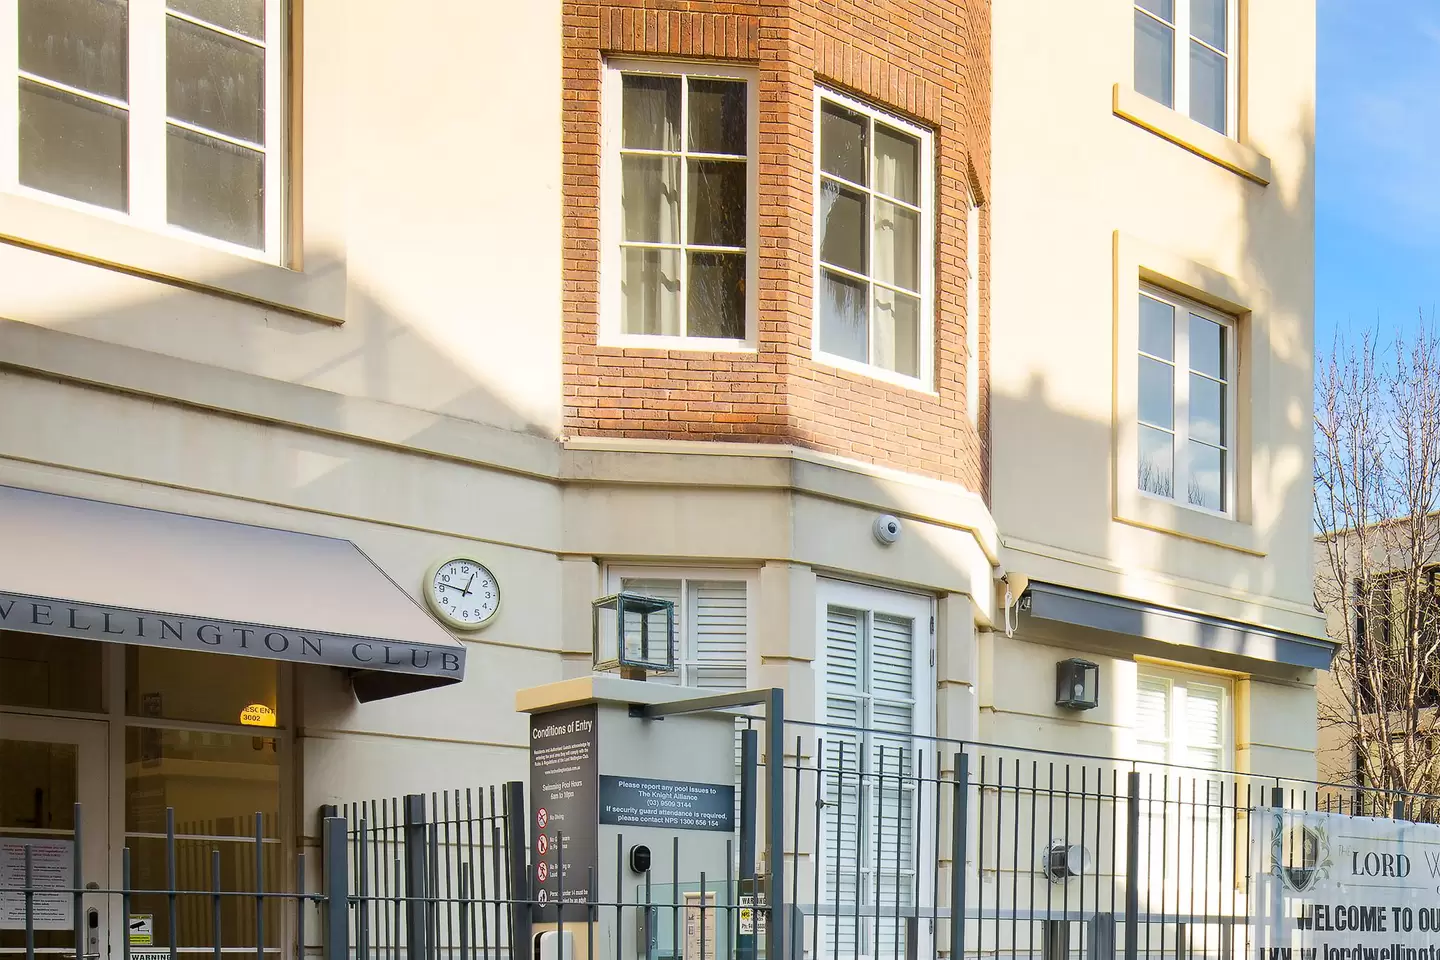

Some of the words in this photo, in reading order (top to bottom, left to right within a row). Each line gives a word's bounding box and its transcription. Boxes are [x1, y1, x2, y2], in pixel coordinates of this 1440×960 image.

[451, 567, 457, 575] 11
[461, 566, 469, 574] 12
[442, 574, 450, 582] 10
[462, 610, 468, 618] 6
[351, 642, 460, 672] CLUB
[243, 714, 261, 722] 3002
[532, 724, 567, 740] Conditions
[567, 721, 575, 734] of
[575, 719, 593, 733] Entry
[542, 783, 561, 791] Swimming
[561, 781, 571, 789] Pool
[618, 780, 641, 789] Please
[641, 783, 661, 792] report
[662, 785, 674, 793] any
[674, 785, 688, 793] pool
[638, 790, 650, 798] The
[651, 791, 673, 800] Knight
[673, 793, 698, 801] Alliance
[646, 799, 660, 807] (03)
[676, 801, 692, 809] 3144
[612, 806, 638, 815] security
[638, 808, 658, 816] guard
[658, 809, 693, 818] attendance
[700, 812, 728, 821] required,
[617, 814, 639, 822] please
[640, 816, 664, 824] contact
[664, 817, 679, 825] NPS
[679, 818, 694, 826] 1300
[1352, 851, 1411, 878] LORD
[1297, 903, 1387, 932] WELCOME
[1392, 907, 1413, 933] TO
